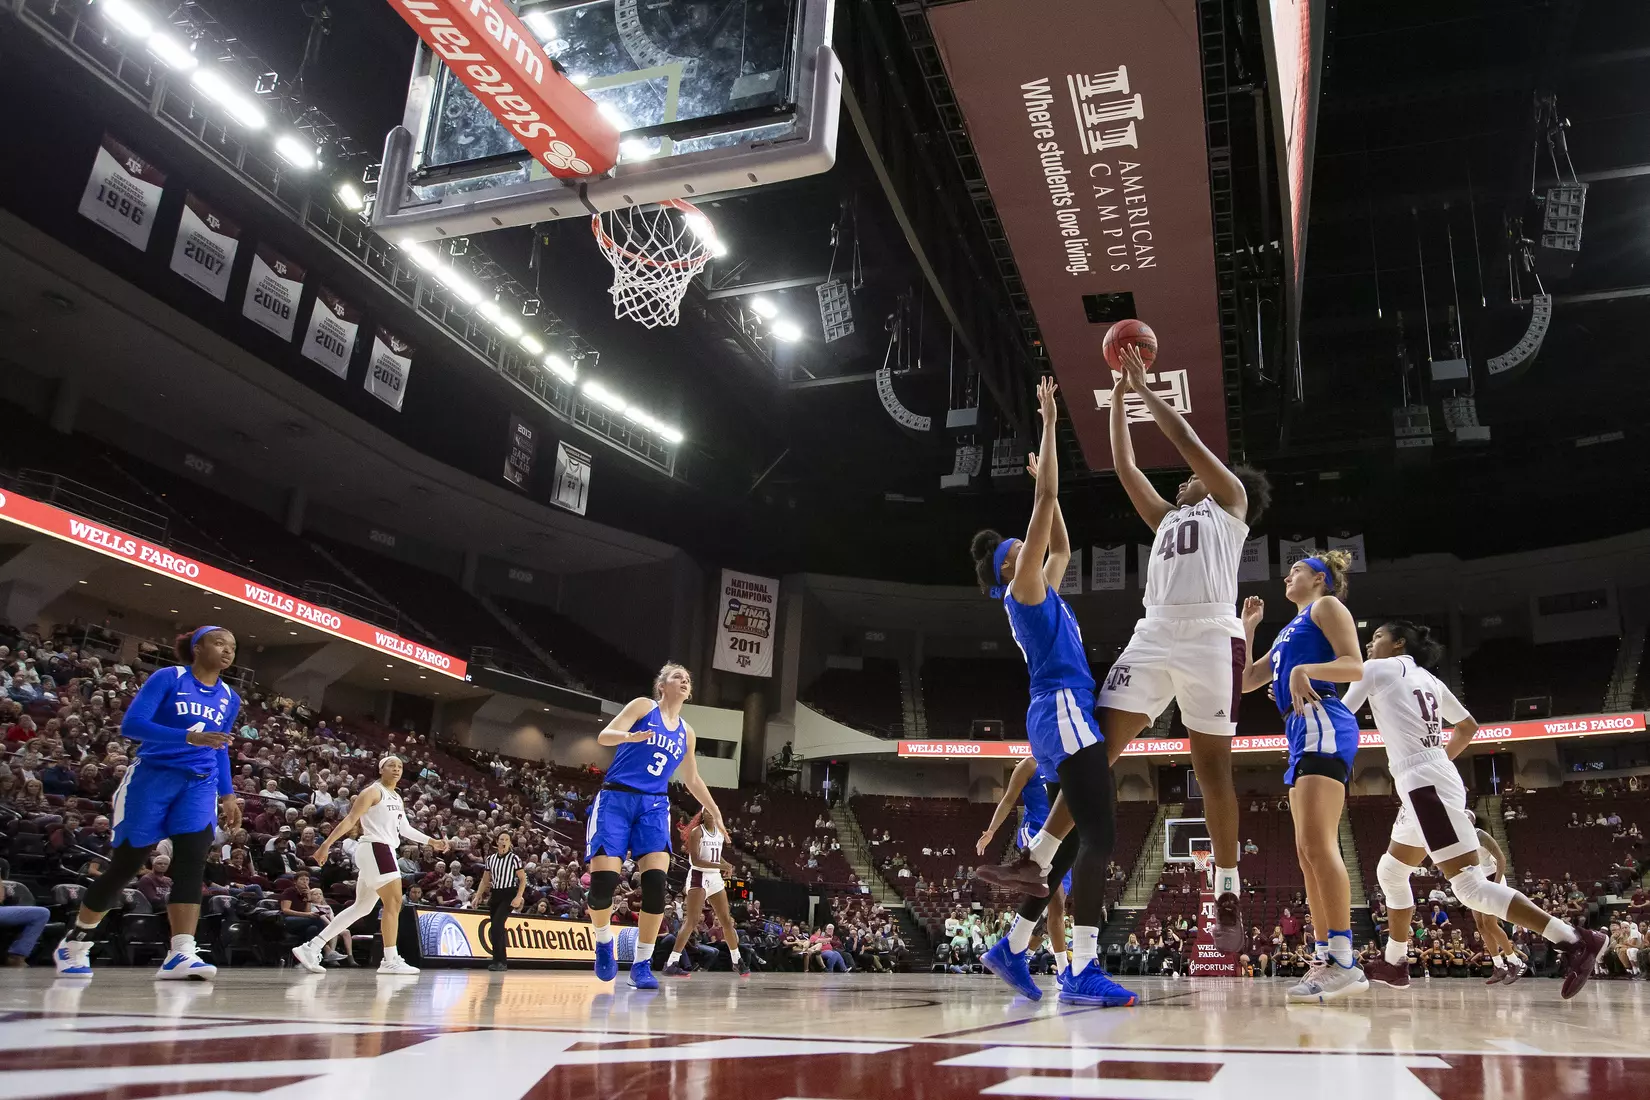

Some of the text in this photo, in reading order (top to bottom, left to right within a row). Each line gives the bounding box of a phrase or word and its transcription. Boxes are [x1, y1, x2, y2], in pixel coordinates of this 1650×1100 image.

[466, 64, 557, 139] State
[1020, 77, 1055, 139] Where
[1037, 141, 1075, 207] students
[96, 184, 144, 226] 1996
[1089, 163, 1130, 272] CAMPUS
[1118, 160, 1157, 269] AMERICAN
[1056, 207, 1081, 237] love
[185, 241, 224, 276] 2007
[254, 287, 290, 320] 2008
[315, 328, 344, 358] 2010
[373, 365, 400, 391] 2013
[517, 423, 532, 440] 2013
[69, 519, 199, 578] WELLS FARGO
[1157, 520, 1199, 560] 40
[725, 587, 772, 604] CHAMPIONS
[731, 578, 768, 594] NATIONAL
[245, 584, 341, 630] WELLS FARGO
[738, 604, 769, 620] FINAL
[375, 632, 450, 669] WELLS FARGO
[729, 637, 761, 654] 2011
[1272, 650, 1281, 681] 2
[175, 701, 224, 726] DUKE
[1413, 689, 1439, 722] 12
[1360, 734, 1384, 744] FAR
[1473, 728, 1511, 740] FARGO
[1544, 717, 1634, 734] WELLS FARGO
[647, 732, 682, 760] DUKE
[907, 744, 981, 754] WELLS FARGO
[1008, 745, 1032, 754] WEL
[1126, 741, 1184, 751] LLS FARGO
[1231, 737, 1288, 748] LLS FARGO
[647, 752, 668, 777] 3
[711, 848, 719, 862] 11
[478, 918, 594, 956] Cntinental
[1190, 960, 1234, 974] OPPORTUNE
